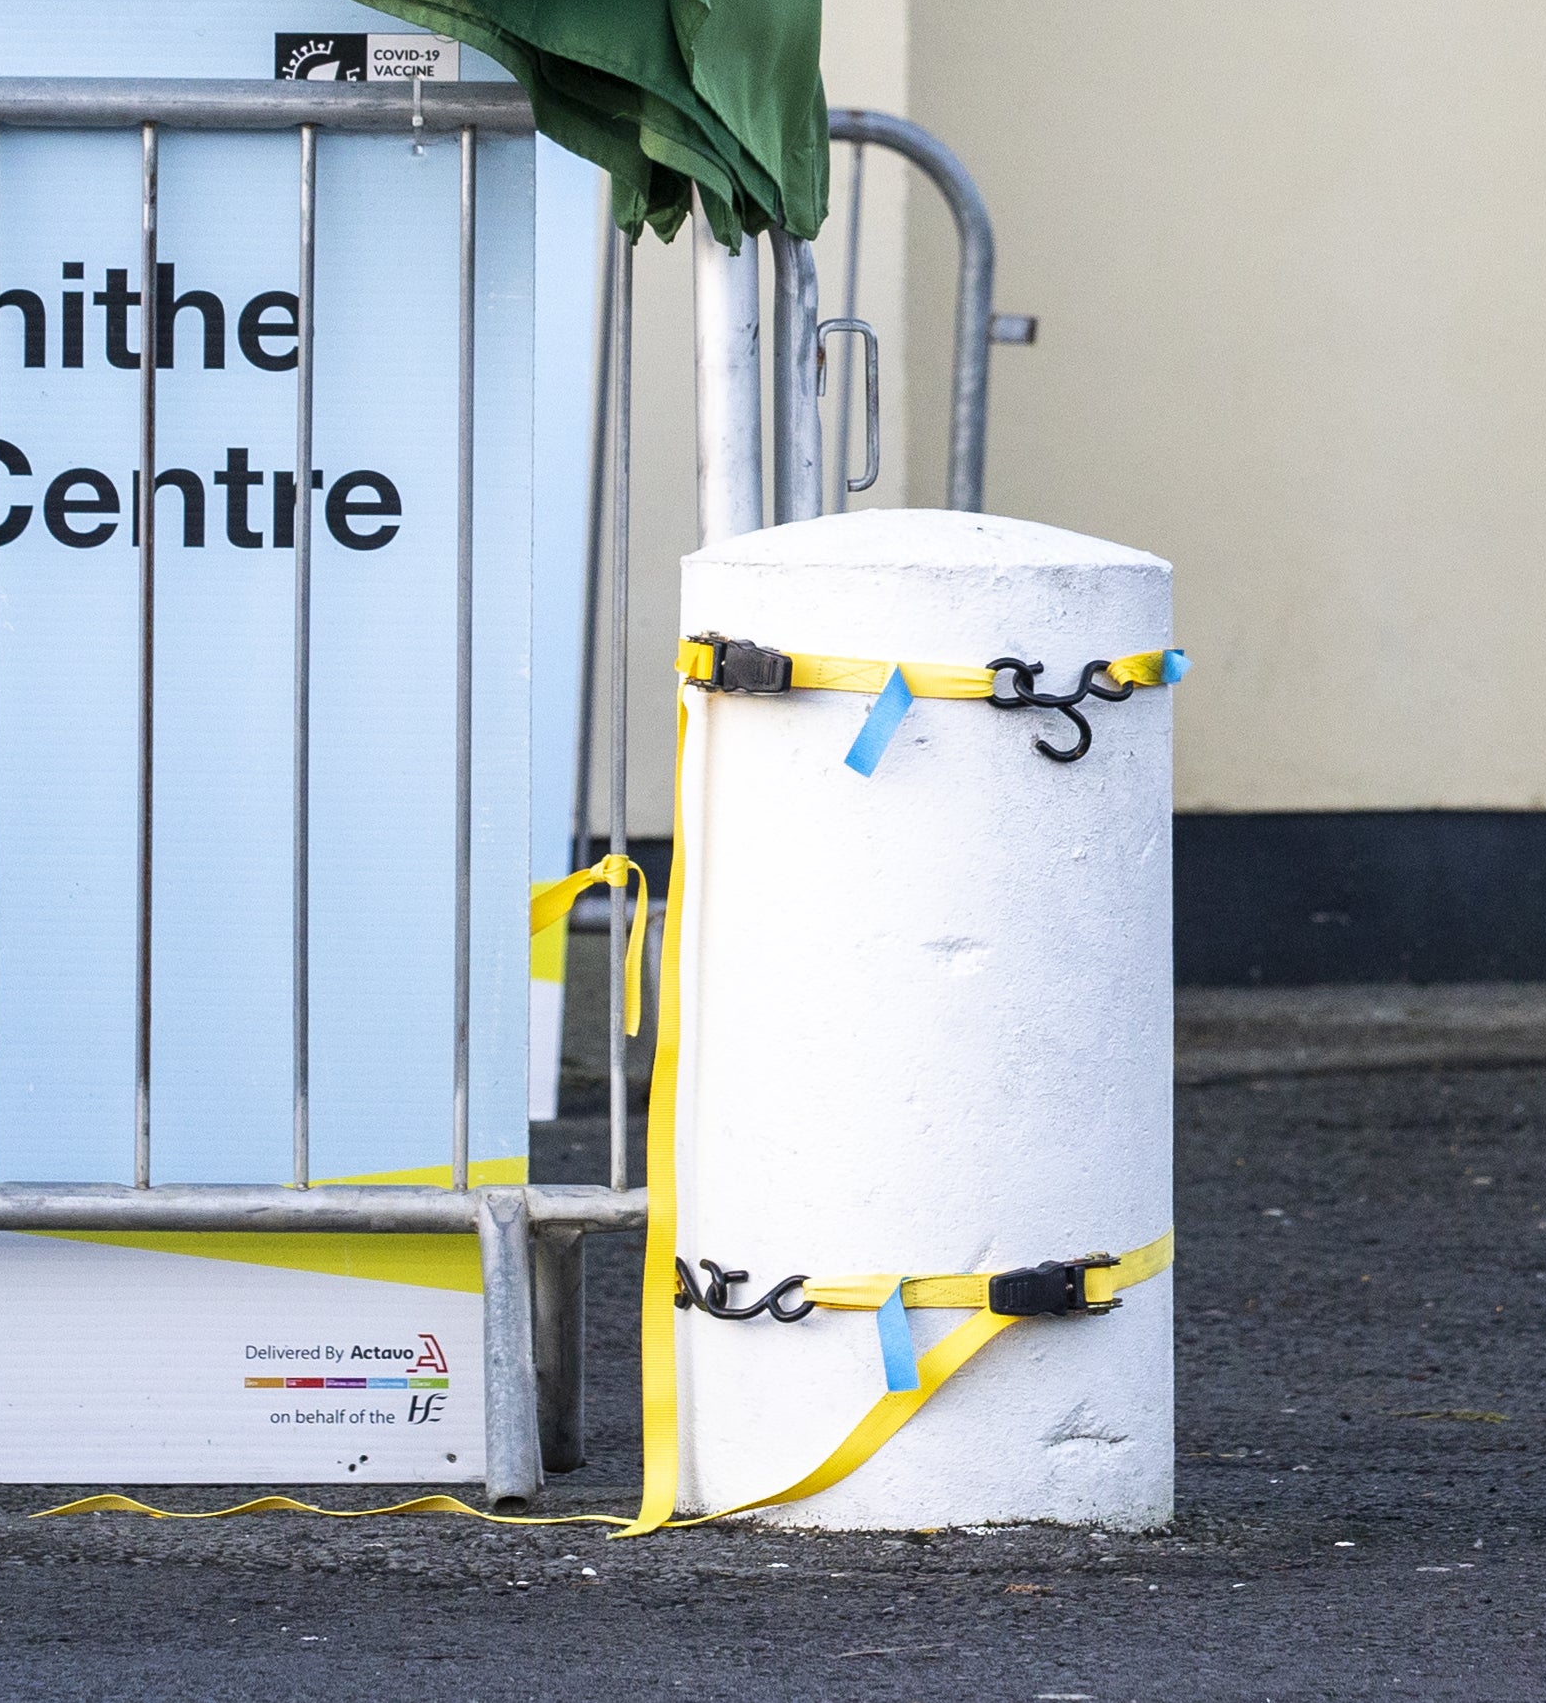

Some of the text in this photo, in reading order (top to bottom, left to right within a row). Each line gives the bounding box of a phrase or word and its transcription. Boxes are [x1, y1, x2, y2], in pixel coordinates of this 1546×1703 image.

[373, 48, 440, 62] COVID-19
[373, 64, 435, 77] VACCINE
[244, 1345, 321, 1361] Delivered
[325, 1345, 345, 1364] By
[350, 1345, 414, 1361] Actavo
[269, 1411, 291, 1424] on
[295, 1408, 347, 1424] behalf
[348, 1408, 366, 1424] of
[366, 1409, 396, 1424] the
